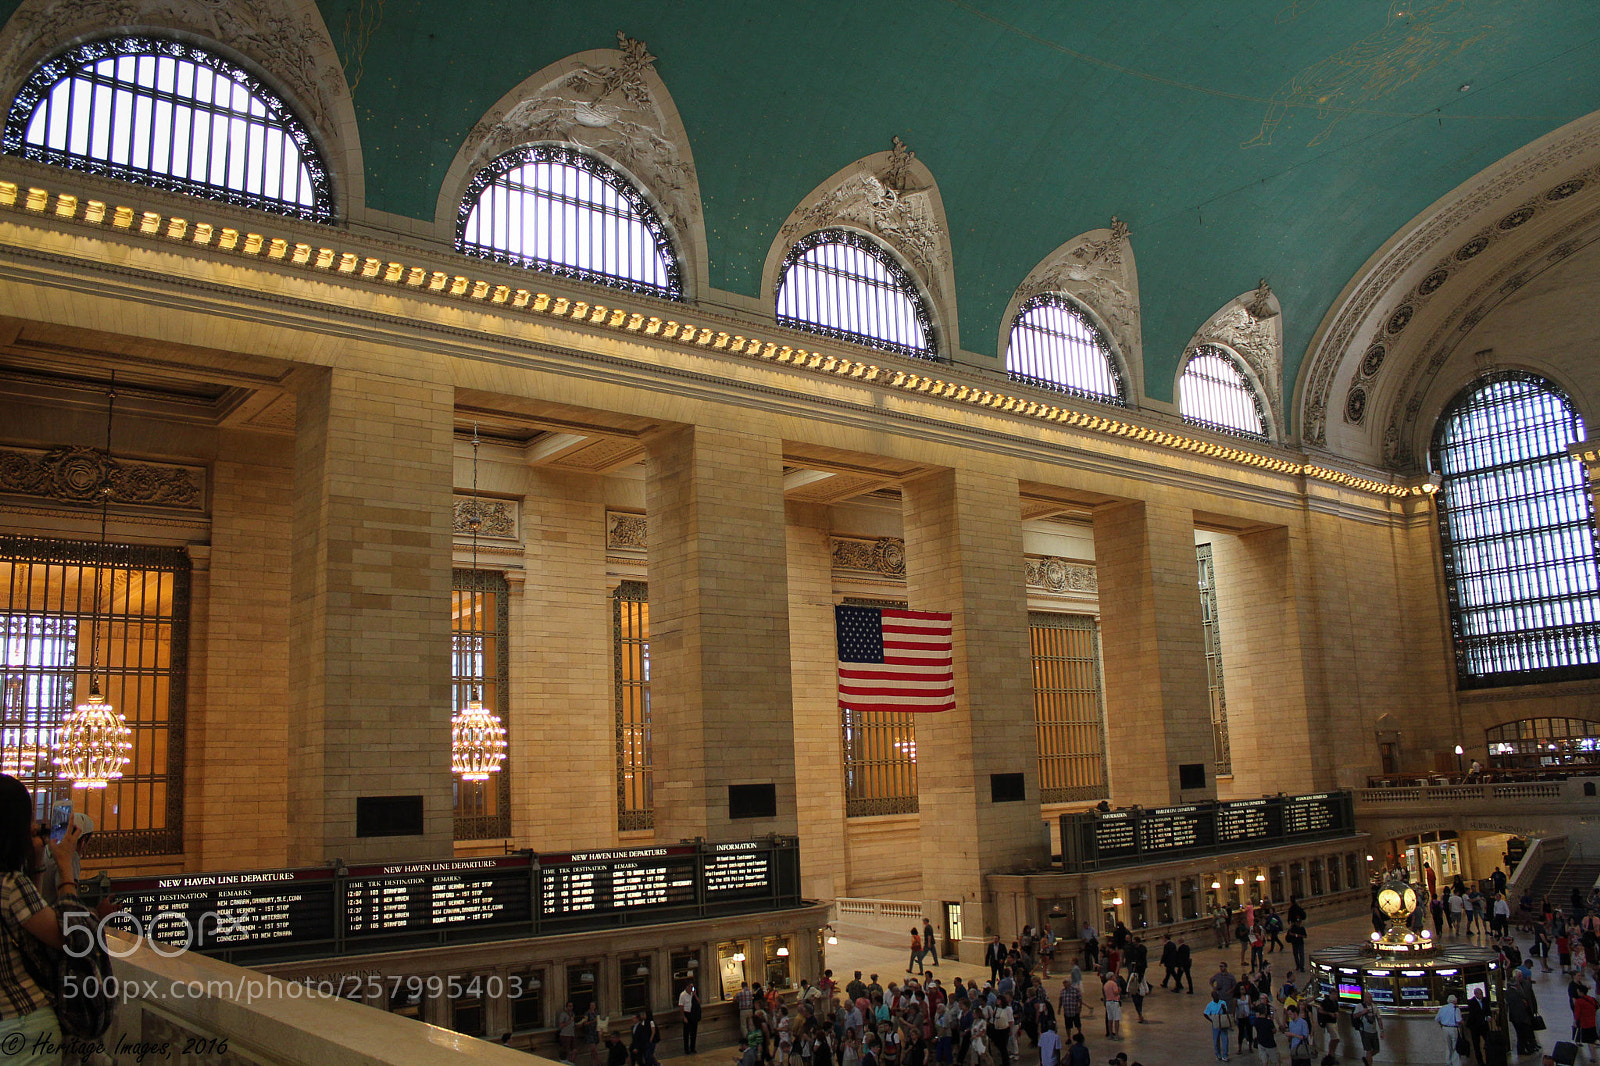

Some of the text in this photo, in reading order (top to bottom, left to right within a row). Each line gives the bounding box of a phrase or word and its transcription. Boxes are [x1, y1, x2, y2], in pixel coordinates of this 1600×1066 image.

[716, 842, 757, 851] INFORMATION
[572, 848, 668, 862] NEW HAVEN LINE DEPARTURES
[384, 866, 402, 874] NEW
[404, 864, 430, 872] HAVEN
[452, 860, 496, 870] DEPARTURES
[572, 865, 608, 873] DESTINATION
[158, 872, 295, 888] NEW HAVEN LINE DEPARTURES
[384, 878, 425, 886] DESTINATION
[160, 892, 208, 902] DESTINATION
[218, 890, 252, 898] REMARKS
[348, 890, 362, 898] 12:07
[172, 902, 190, 910] HAVEN
[348, 898, 362, 906] 12:34
[158, 912, 186, 920] STAMFORD
[216, 908, 234, 916] MOUNT
[114, 916, 132, 924] 11:07
[216, 916, 250, 924] CONNECTION
[261, 913, 290, 921] WATERBURY
[171, 920, 189, 928] HAVEN
[158, 930, 186, 938] STAMFORD
[216, 926, 233, 934] MOUNT
[216, 934, 250, 942] CONNECTION
[273, 930, 293, 938] CANAAN
[328, 968, 382, 982] MACHINES
